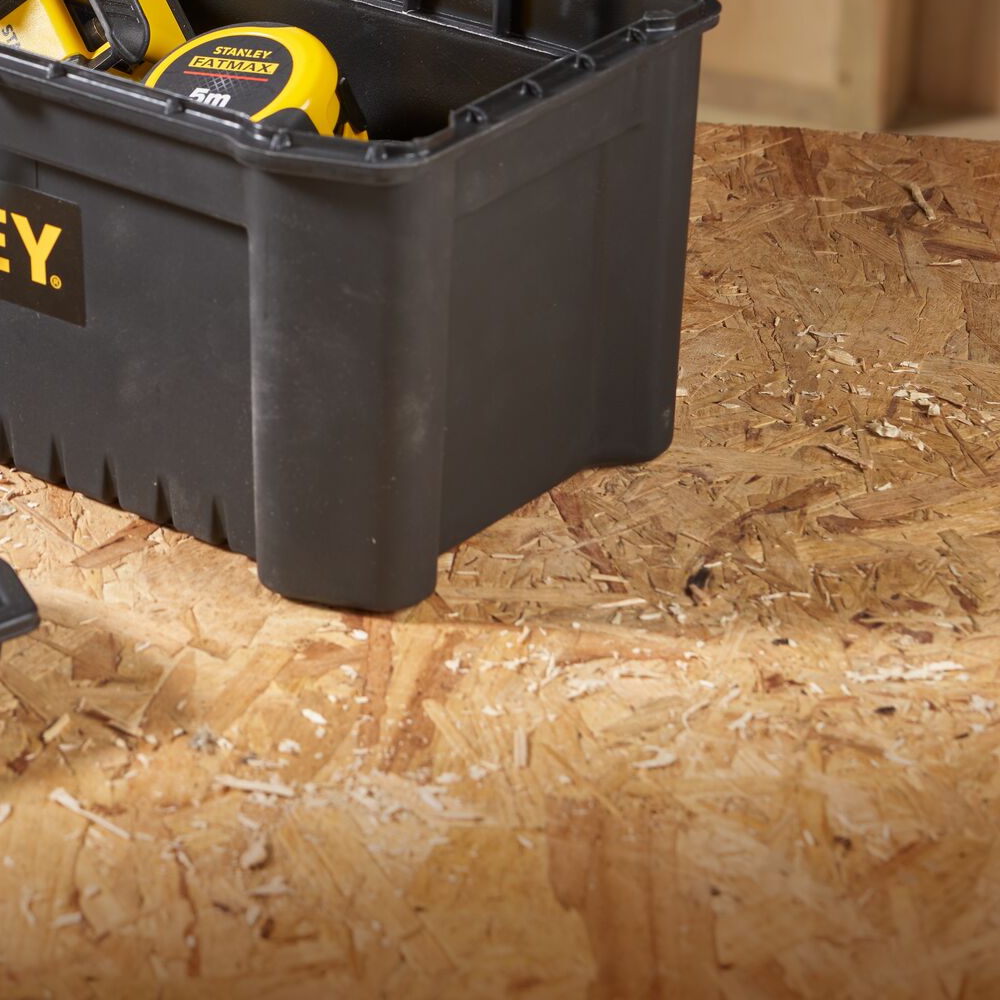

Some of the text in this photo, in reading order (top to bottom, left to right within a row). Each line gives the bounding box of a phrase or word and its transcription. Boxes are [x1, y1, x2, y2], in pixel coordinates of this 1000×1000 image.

[212, 46, 273, 59] STANLEY
[192, 57, 272, 73] FATMAX
[189, 87, 231, 108] 5m
